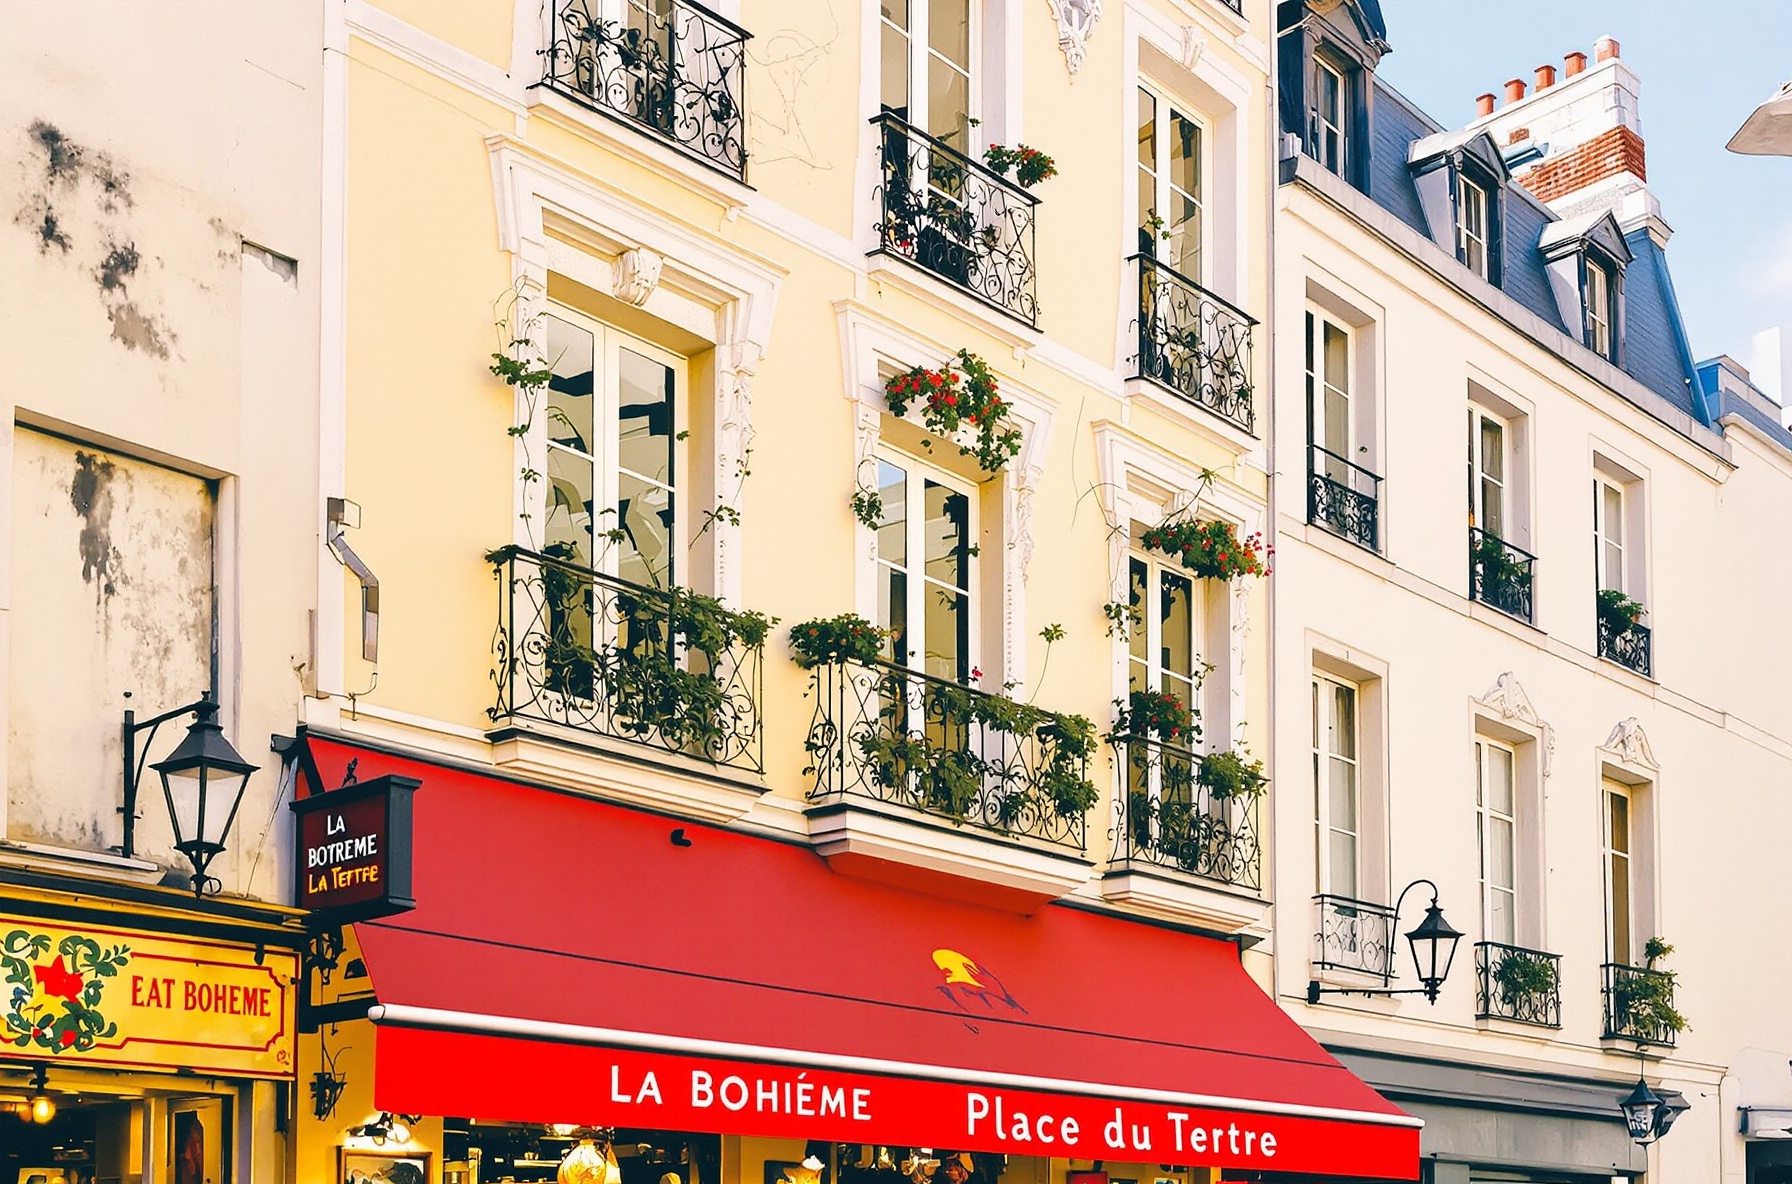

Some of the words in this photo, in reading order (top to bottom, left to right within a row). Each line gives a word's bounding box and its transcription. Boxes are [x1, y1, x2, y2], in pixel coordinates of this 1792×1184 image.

[327, 814, 346, 836] LA
[131, 975, 176, 1009] EAT
[184, 980, 272, 1017] BOHEME
[611, 1064, 663, 1105] LA
[691, 1070, 872, 1121] BOHIÉME
[967, 1092, 1080, 1145] Place
[1103, 1107, 1152, 1151] du
[1167, 1111, 1278, 1157] Tertre
